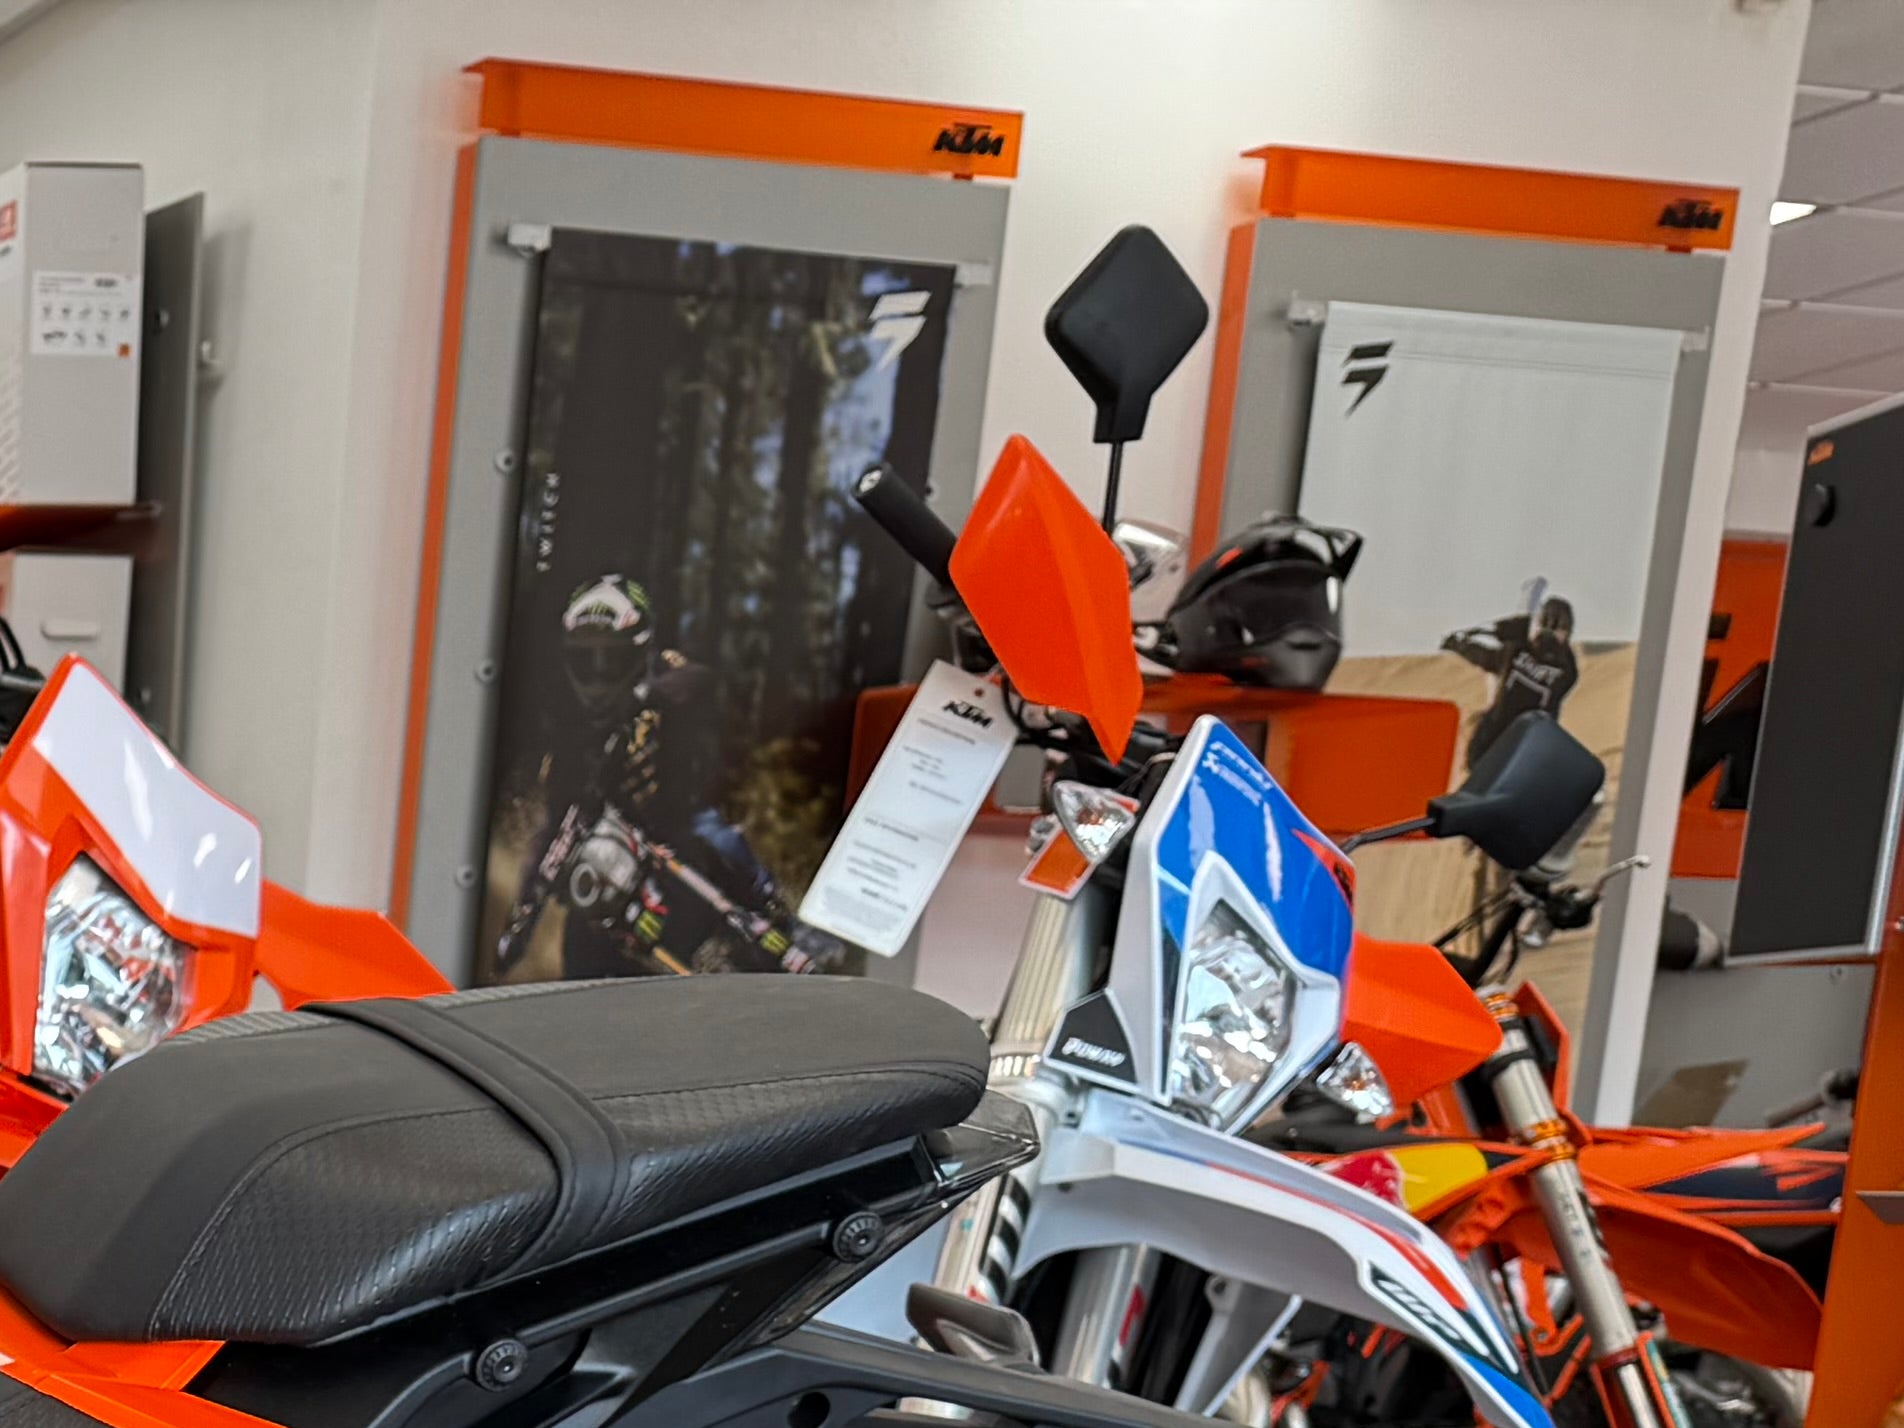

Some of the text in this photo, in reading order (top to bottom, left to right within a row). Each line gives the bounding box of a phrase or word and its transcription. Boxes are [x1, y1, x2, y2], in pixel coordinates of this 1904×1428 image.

[934, 123, 1005, 156] KTM
[1657, 198, 1724, 232] KTM
[943, 700, 993, 729] KTM
